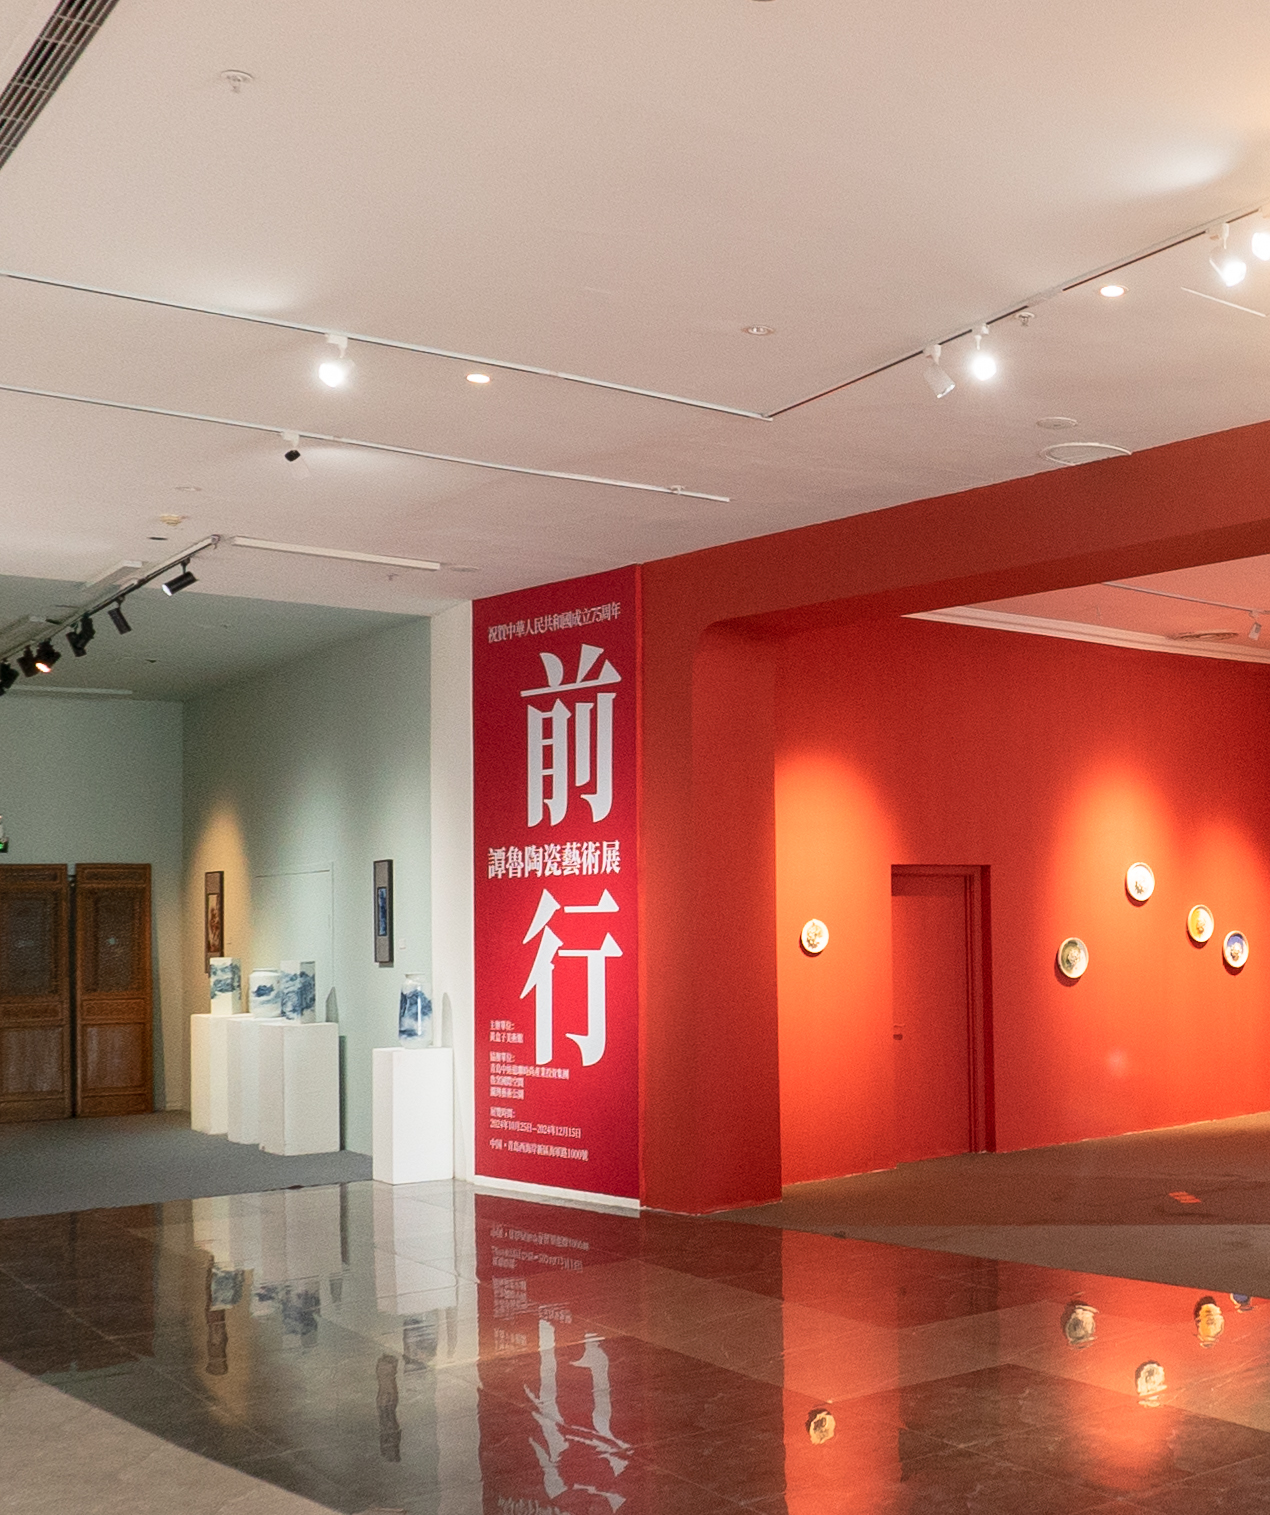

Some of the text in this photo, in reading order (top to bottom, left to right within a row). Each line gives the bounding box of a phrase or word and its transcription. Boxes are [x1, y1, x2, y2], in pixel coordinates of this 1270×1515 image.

[520, 643, 622, 827] 前
[488, 840, 621, 879] 譚魯陶瓷藝術展
[520, 888, 624, 1067] 行
